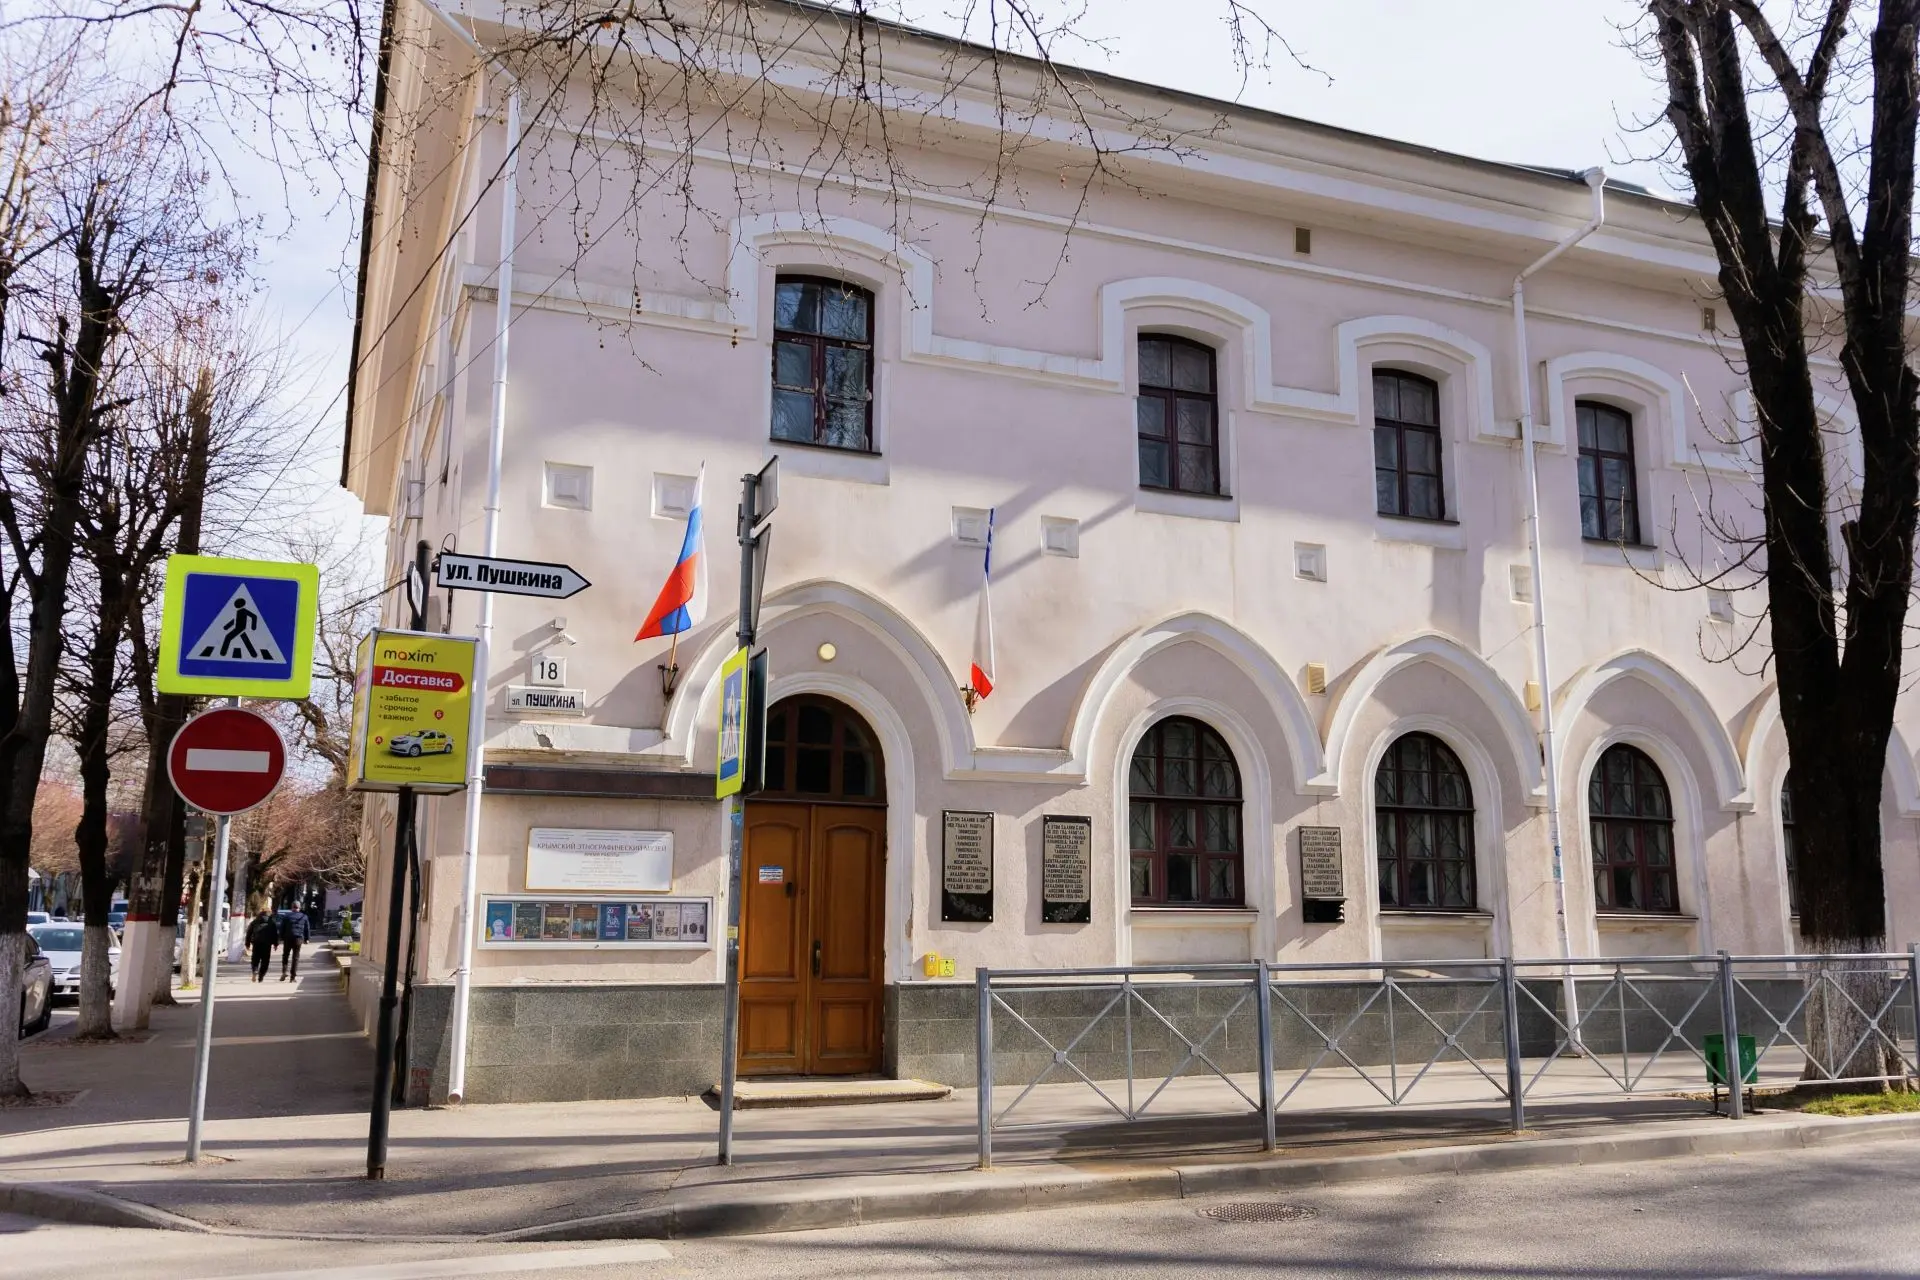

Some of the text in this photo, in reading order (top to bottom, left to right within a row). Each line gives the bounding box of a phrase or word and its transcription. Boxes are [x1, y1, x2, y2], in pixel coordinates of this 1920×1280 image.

[446, 564, 562, 590] ул. Пушкина
[383, 649, 435, 663] maxim
[540, 661, 558, 680] 18
[381, 669, 453, 688] Доставка
[384, 694, 420, 703] забытое
[525, 693, 576, 708] ПУШКИНА
[383, 704, 418, 713] срочное
[382, 714, 415, 722] важное
[537, 842, 576, 850] КРЫМСКИЙ
[578, 843, 643, 852] ЭТНОГРАФИЧЕСКИЙ
